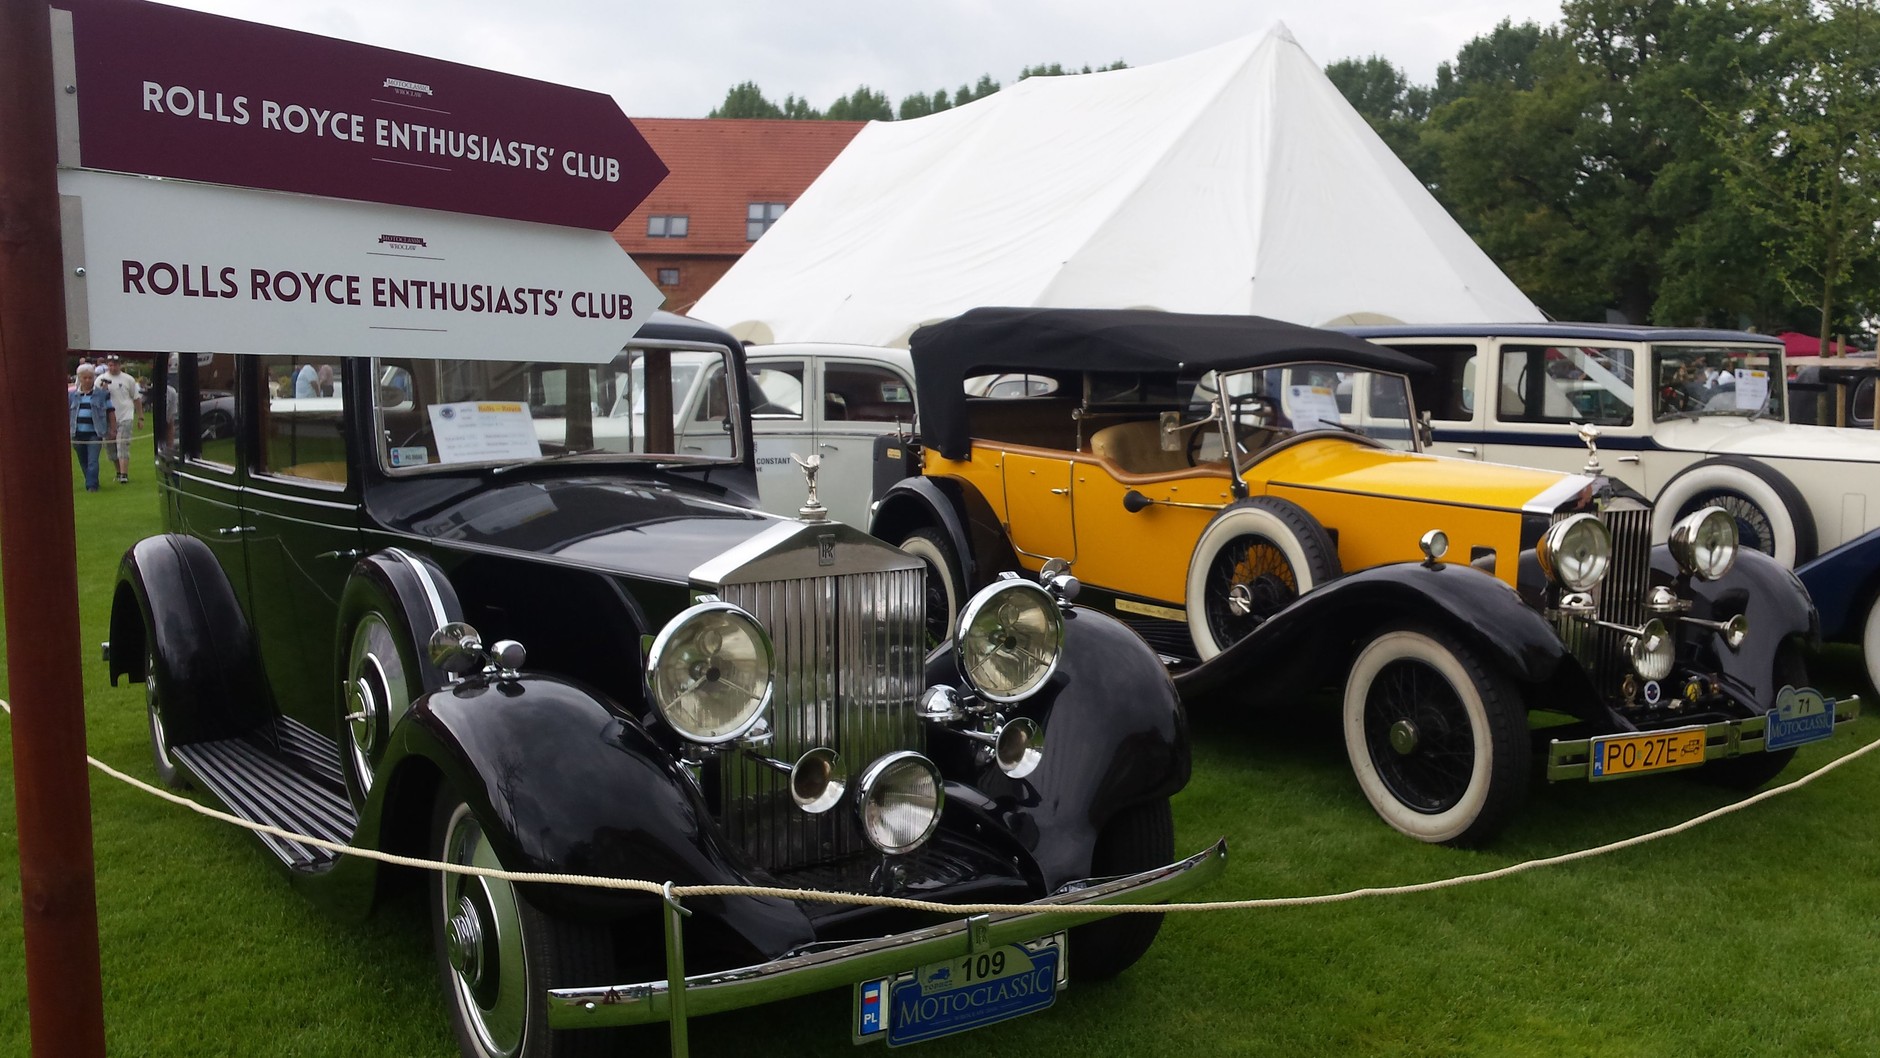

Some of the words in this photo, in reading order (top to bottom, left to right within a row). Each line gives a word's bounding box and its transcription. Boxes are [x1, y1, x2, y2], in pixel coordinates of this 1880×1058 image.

[143, 80, 250, 125] ROLLS
[262, 100, 365, 143] ROYCE
[376, 118, 555, 171] ENTHUSIASTS'
[562, 151, 620, 183] CLUB
[121, 259, 239, 299] ROLLS
[250, 268, 362, 306] ROYCE
[372, 277, 564, 317] ENTHUSIASTS'
[571, 291, 633, 320] CLUB
[756, 457, 791, 465] CONSTANT
[1798, 698, 1810, 714] 71
[1770, 711, 1832, 738] MOTOCLASSIC
[1607, 743, 1636, 770] PO
[1643, 737, 1678, 766] 27E
[961, 951, 1006, 982] 109
[899, 966, 1050, 1028] MOTOCLASSIC
[864, 1012, 878, 1025] PL
